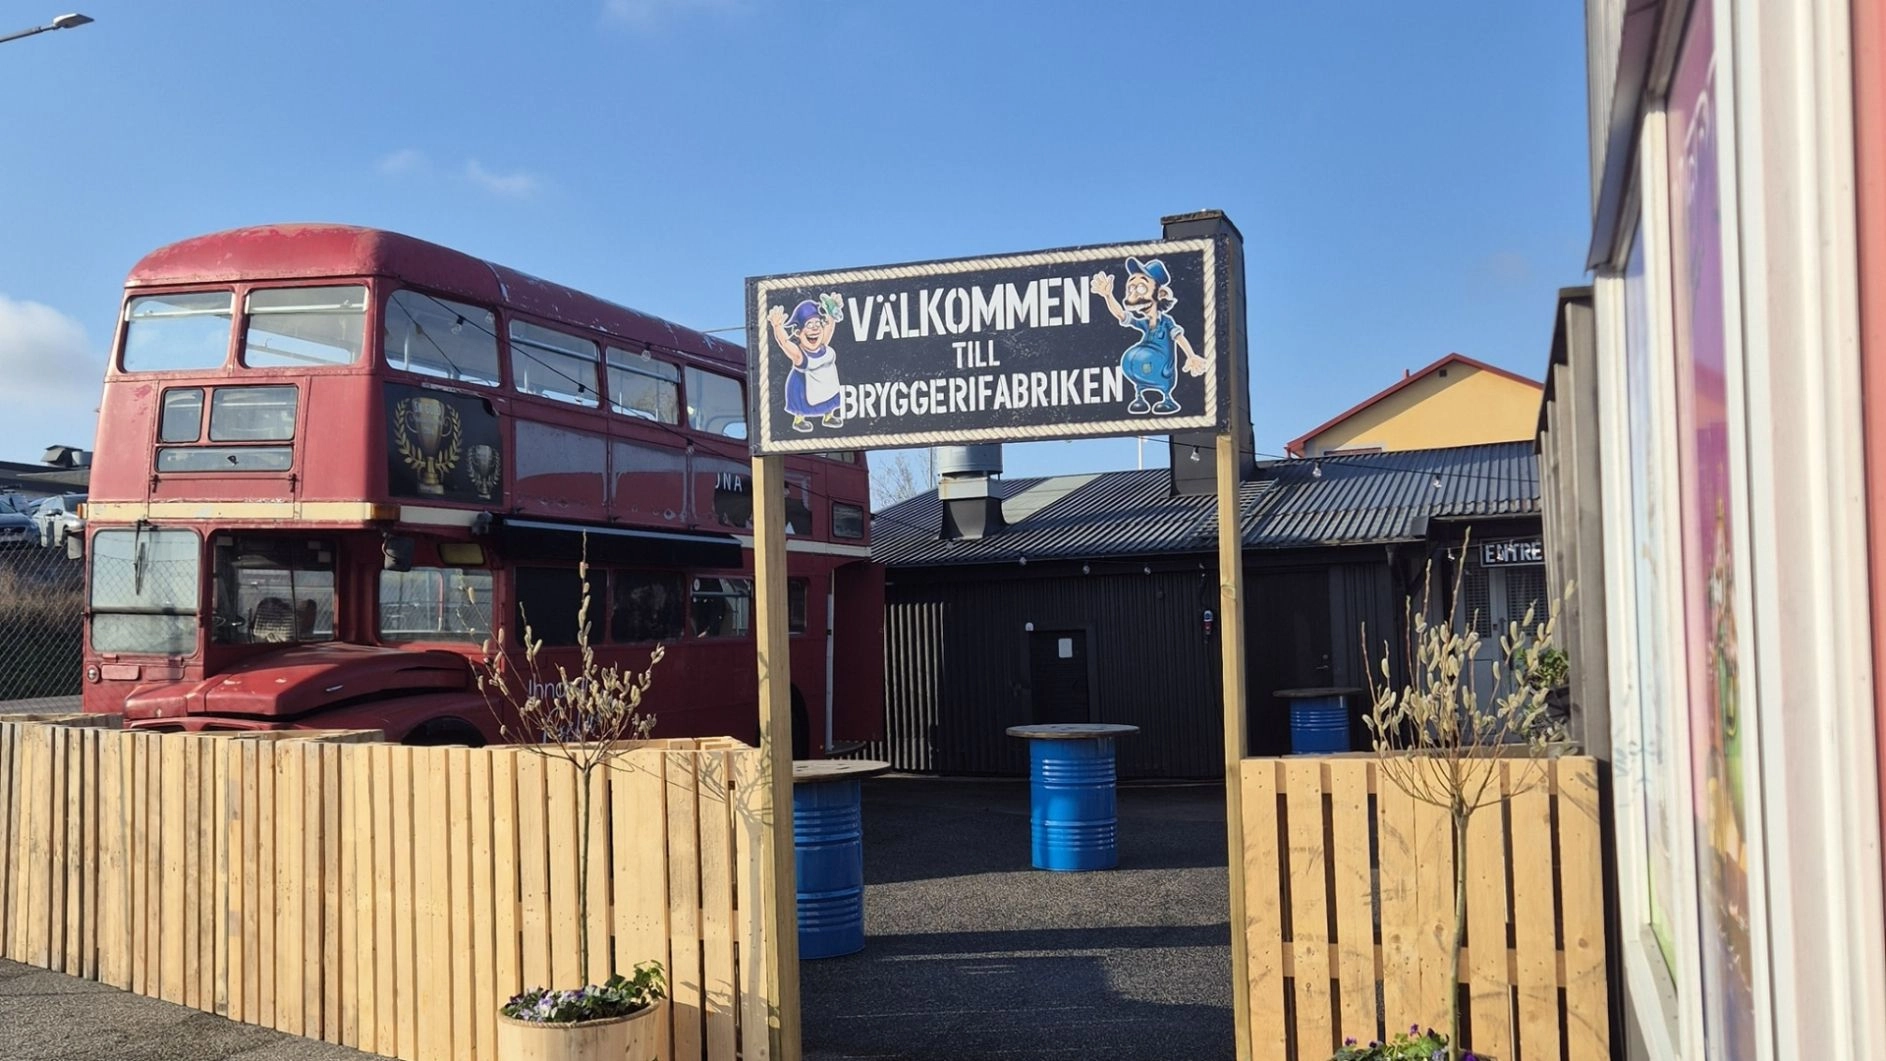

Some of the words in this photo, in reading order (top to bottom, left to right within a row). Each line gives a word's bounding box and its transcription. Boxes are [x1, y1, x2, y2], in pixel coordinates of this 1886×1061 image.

[848, 276, 1090, 342] VÄLKOMMEN
[952, 340, 1000, 369] TILL
[840, 365, 1123, 420] BRYGGERIFABRIKEN
